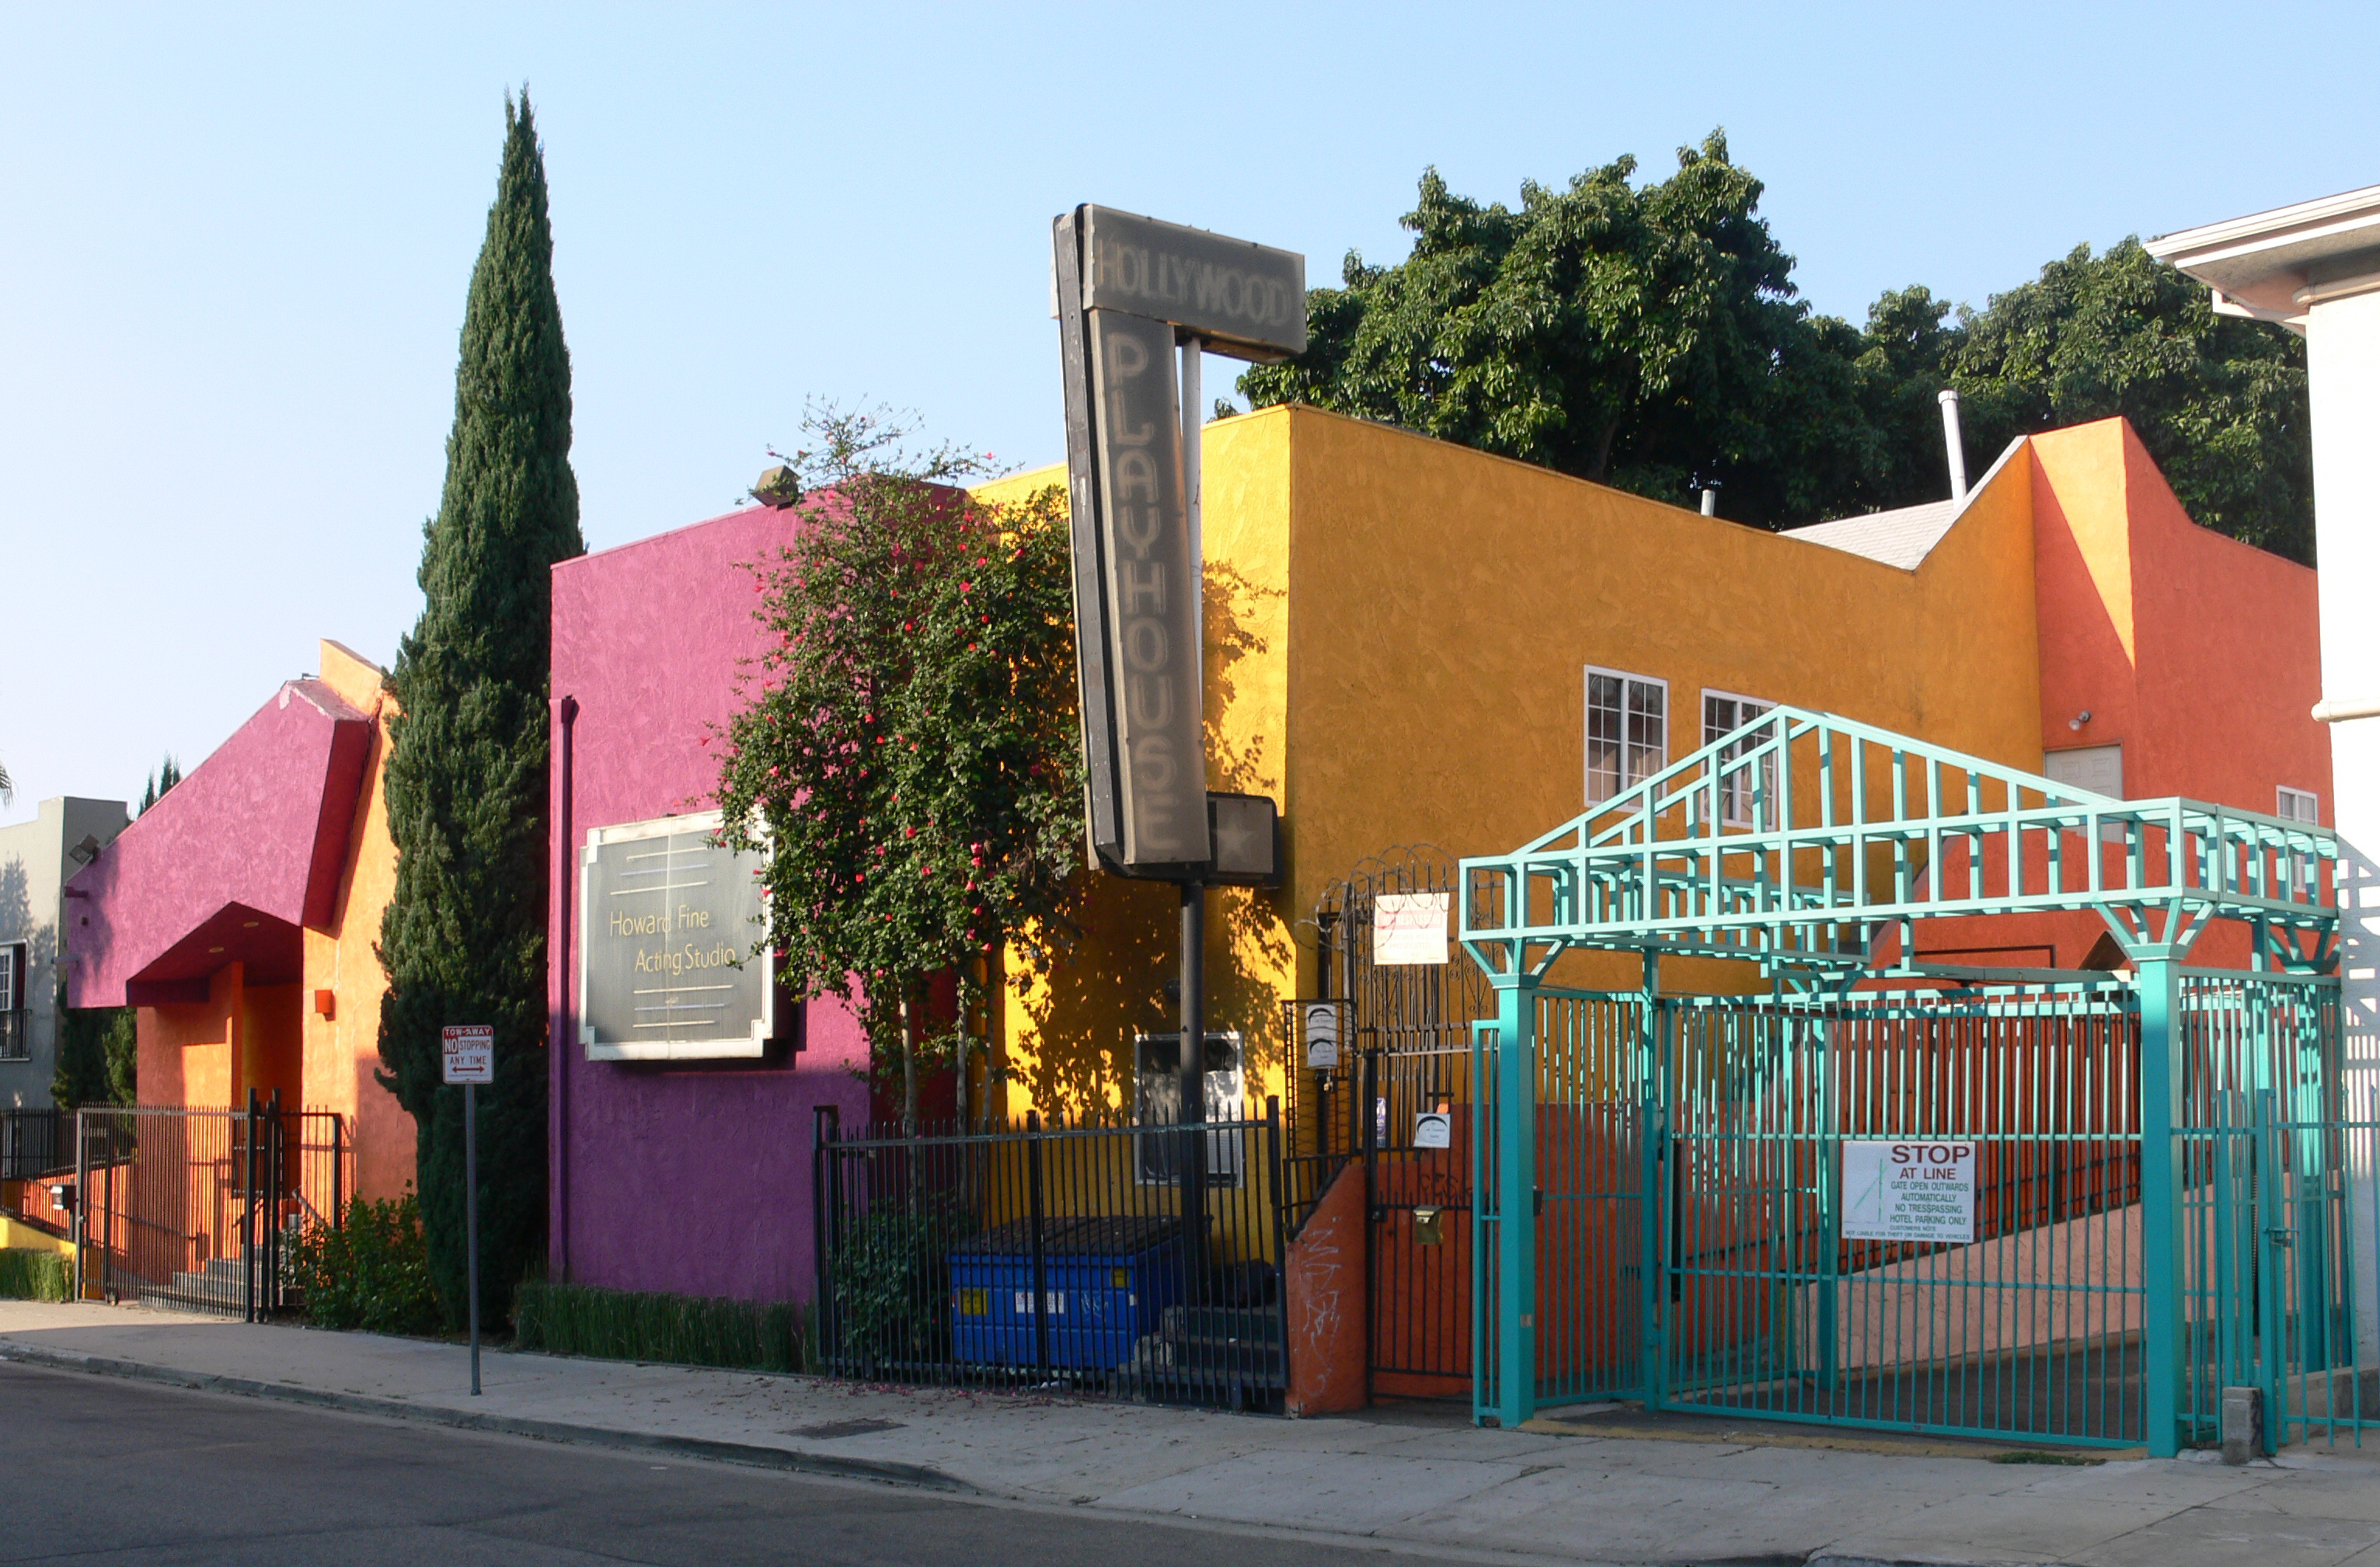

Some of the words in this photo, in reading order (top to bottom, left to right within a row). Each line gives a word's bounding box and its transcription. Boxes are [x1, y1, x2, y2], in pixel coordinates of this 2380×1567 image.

[1096, 238, 1291, 327] HOLLYWOOD
[1106, 333, 1181, 850] PLAYHOUSE
[610, 907, 671, 938] Howard
[678, 904, 709, 929] Fine
[635, 948, 682, 976] Acting
[685, 942, 736, 970] Studio
[444, 1027, 490, 1036] TOW-AWAY
[444, 1038, 458, 1053] NO
[459, 1039, 490, 1050] STOPPING
[450, 1056, 465, 1064] ANY
[469, 1056, 487, 1064] TIME
[1891, 1144, 1970, 1164] STOP
[1899, 1167, 1917, 1179] AT
[1924, 1168, 1957, 1180] LINE
[1890, 1181, 1908, 1190] GATE
[1910, 1182, 1929, 1190] OPEN
[1932, 1182, 1969, 1192] OUTWARDS
[1901, 1193, 1957, 1203] AUTOMATICALLY
[1895, 1203, 1906, 1212] NO
[1908, 1203, 1962, 1214] TRESSPASSING
[1890, 1214, 1912, 1224] HOTEL
[1915, 1215, 1946, 1224] PARKING
[1949, 1216, 1967, 1225] ONLY
